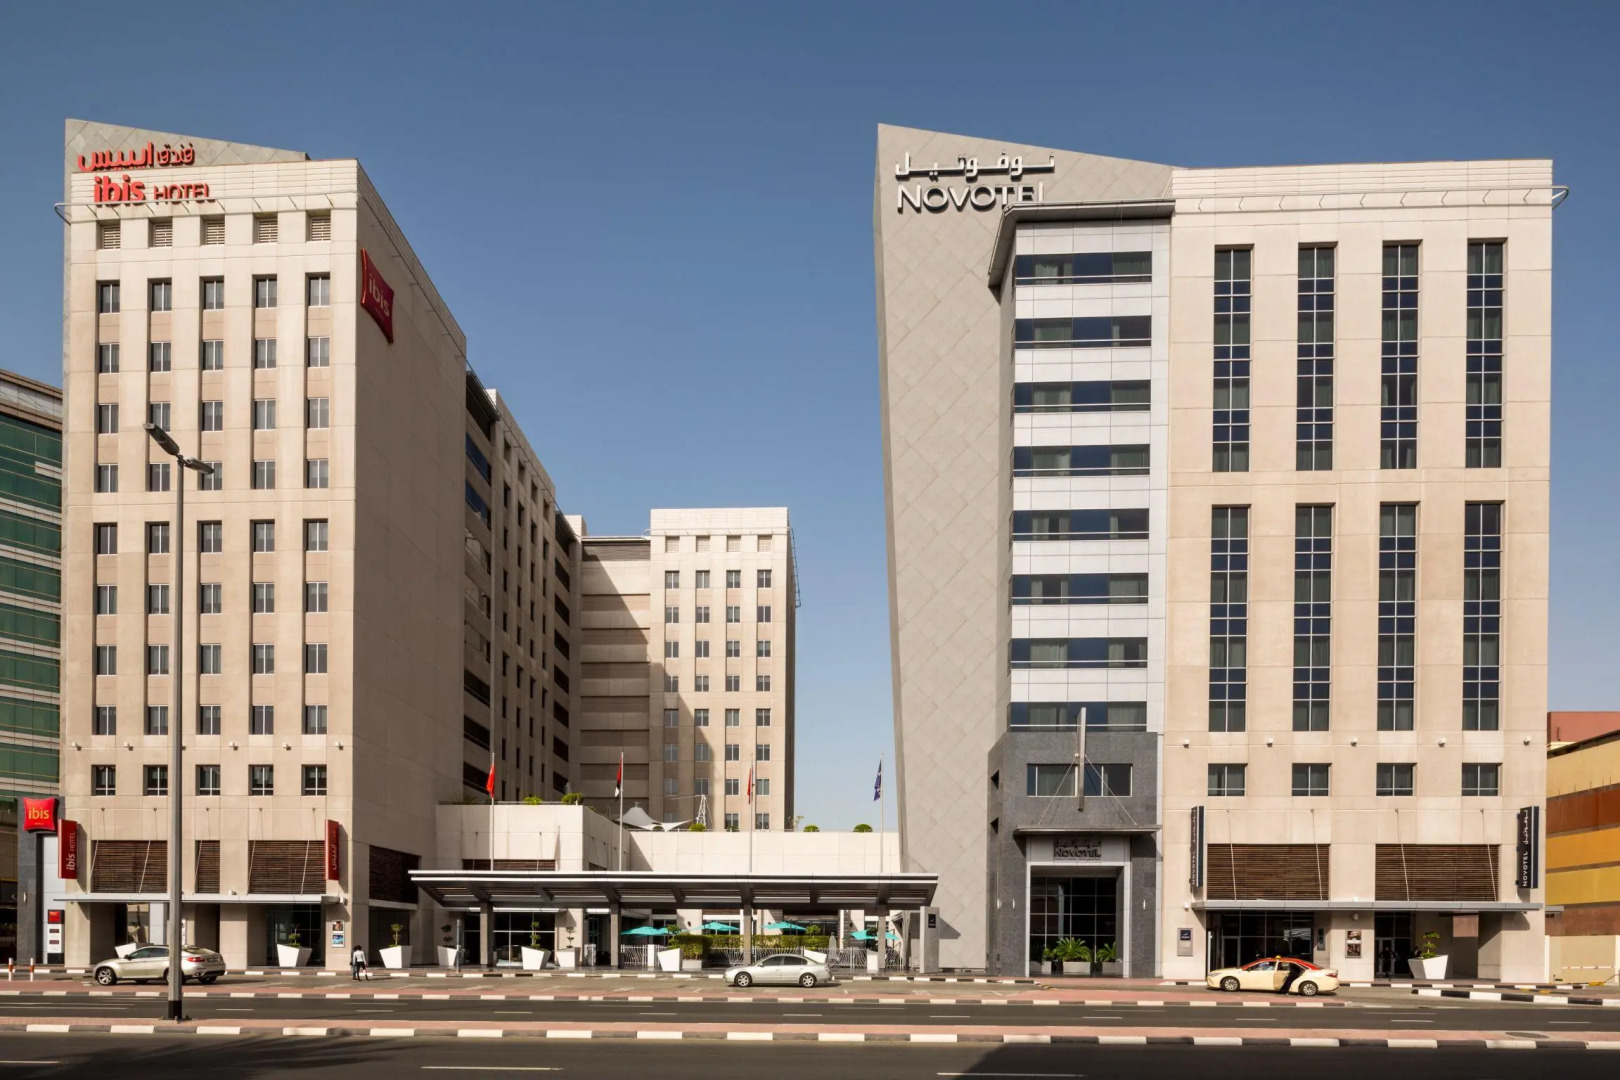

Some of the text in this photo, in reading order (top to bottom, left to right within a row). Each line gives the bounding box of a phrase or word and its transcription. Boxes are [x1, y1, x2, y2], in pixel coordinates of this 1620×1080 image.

[155, 143, 194, 165] فندق
[93, 174, 216, 206] ibis HOTEL
[368, 273, 390, 317] ibis
[28, 807, 50, 820] ibis
[66, 853, 76, 871] ibis
[1053, 848, 1102, 858] NOVOTEL
